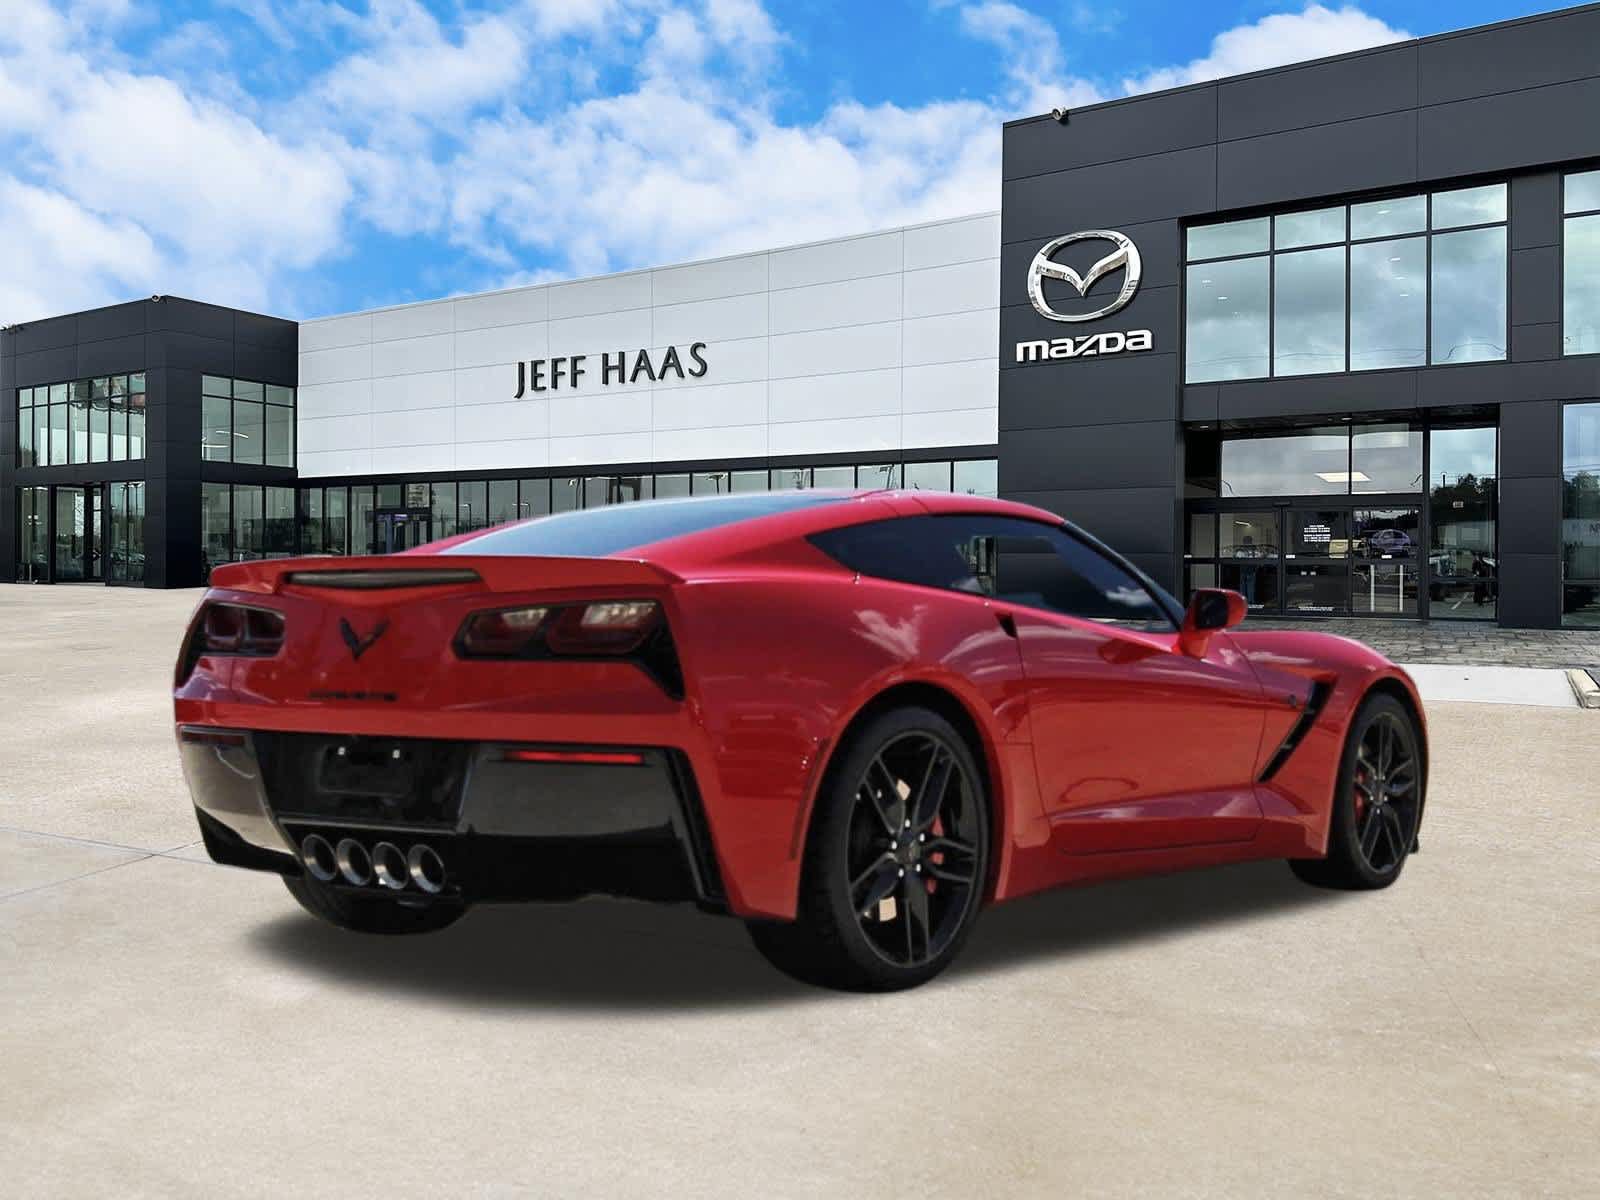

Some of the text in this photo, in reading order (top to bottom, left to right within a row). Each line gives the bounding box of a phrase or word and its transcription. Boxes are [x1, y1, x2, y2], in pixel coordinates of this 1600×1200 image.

[1016, 329, 1153, 363] mazda
[513, 342, 708, 399] JEFF HAAS
